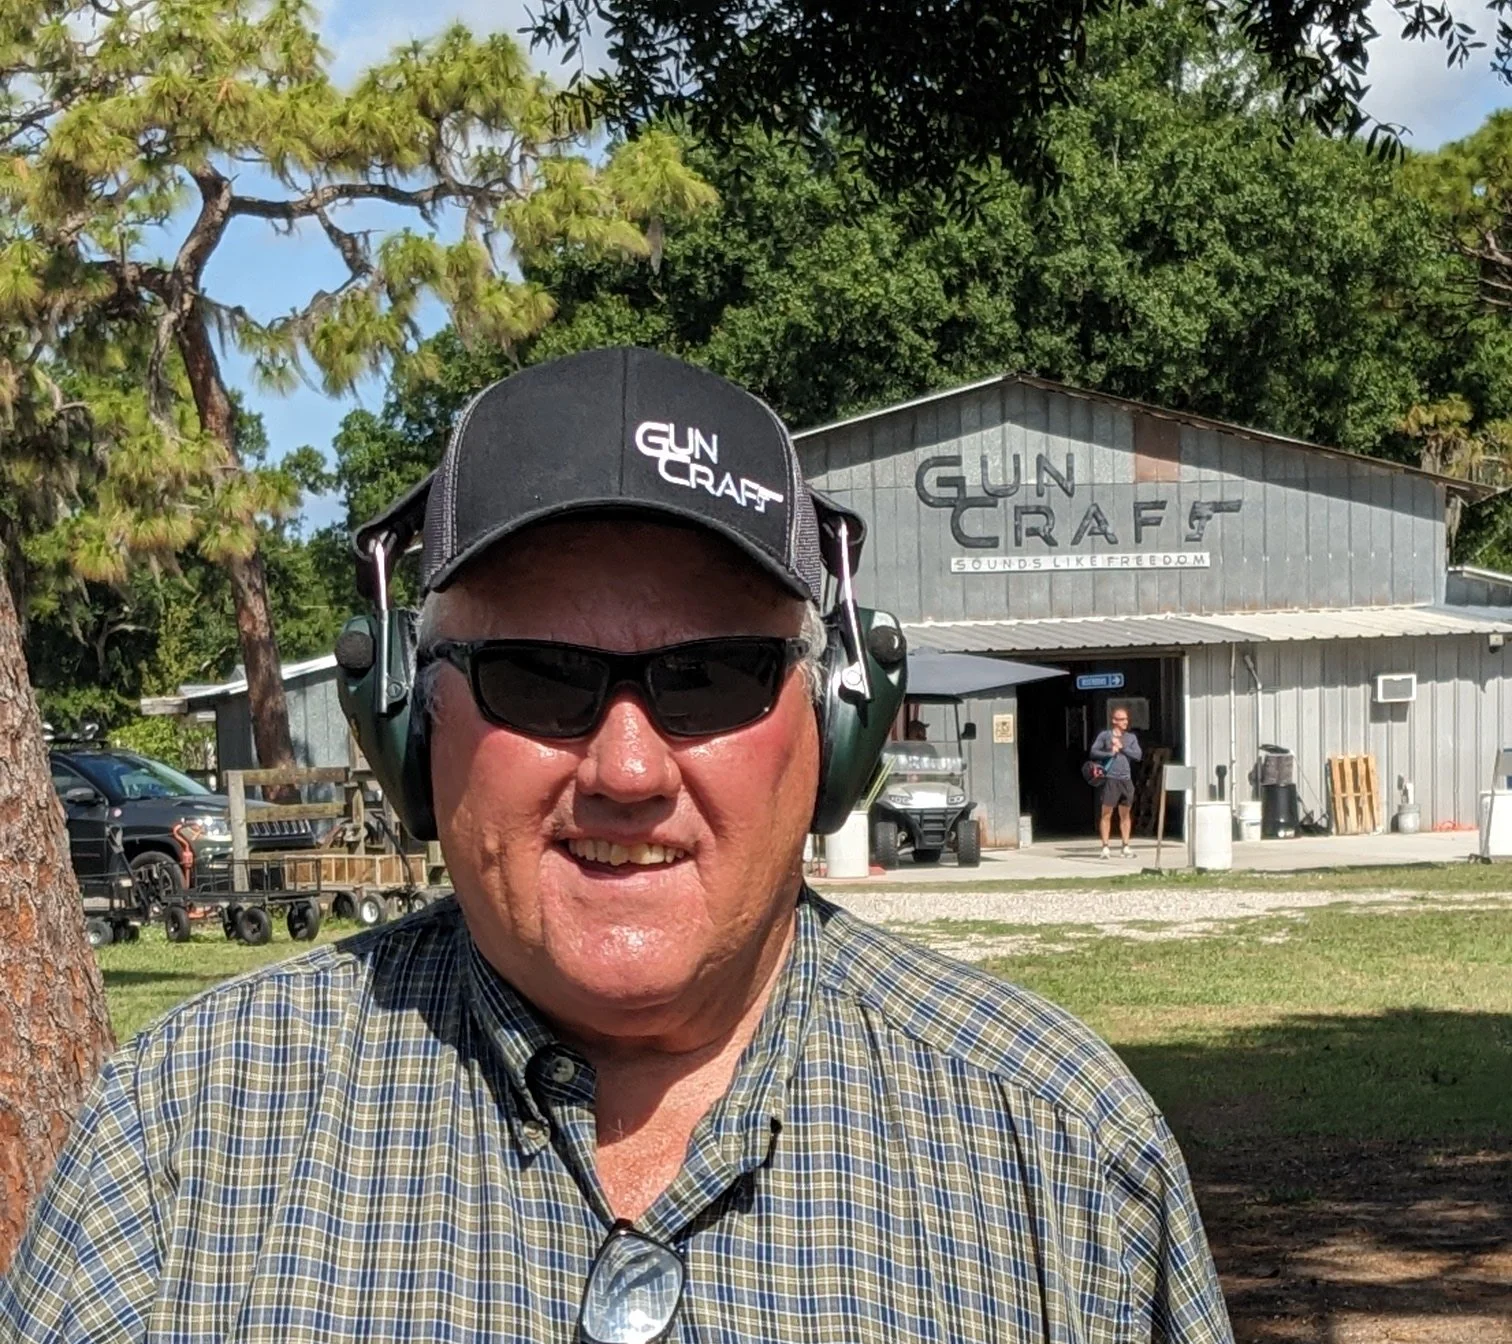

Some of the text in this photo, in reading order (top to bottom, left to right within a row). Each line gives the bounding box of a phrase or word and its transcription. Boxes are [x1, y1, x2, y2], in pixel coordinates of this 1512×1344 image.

[635, 421, 718, 464] GUN
[658, 453, 784, 513] CRAFT
[915, 453, 1075, 508] GUN
[951, 499, 1242, 548] CRAFT
[955, 555, 1206, 570] SOUNDS LIKE FREEDOM
